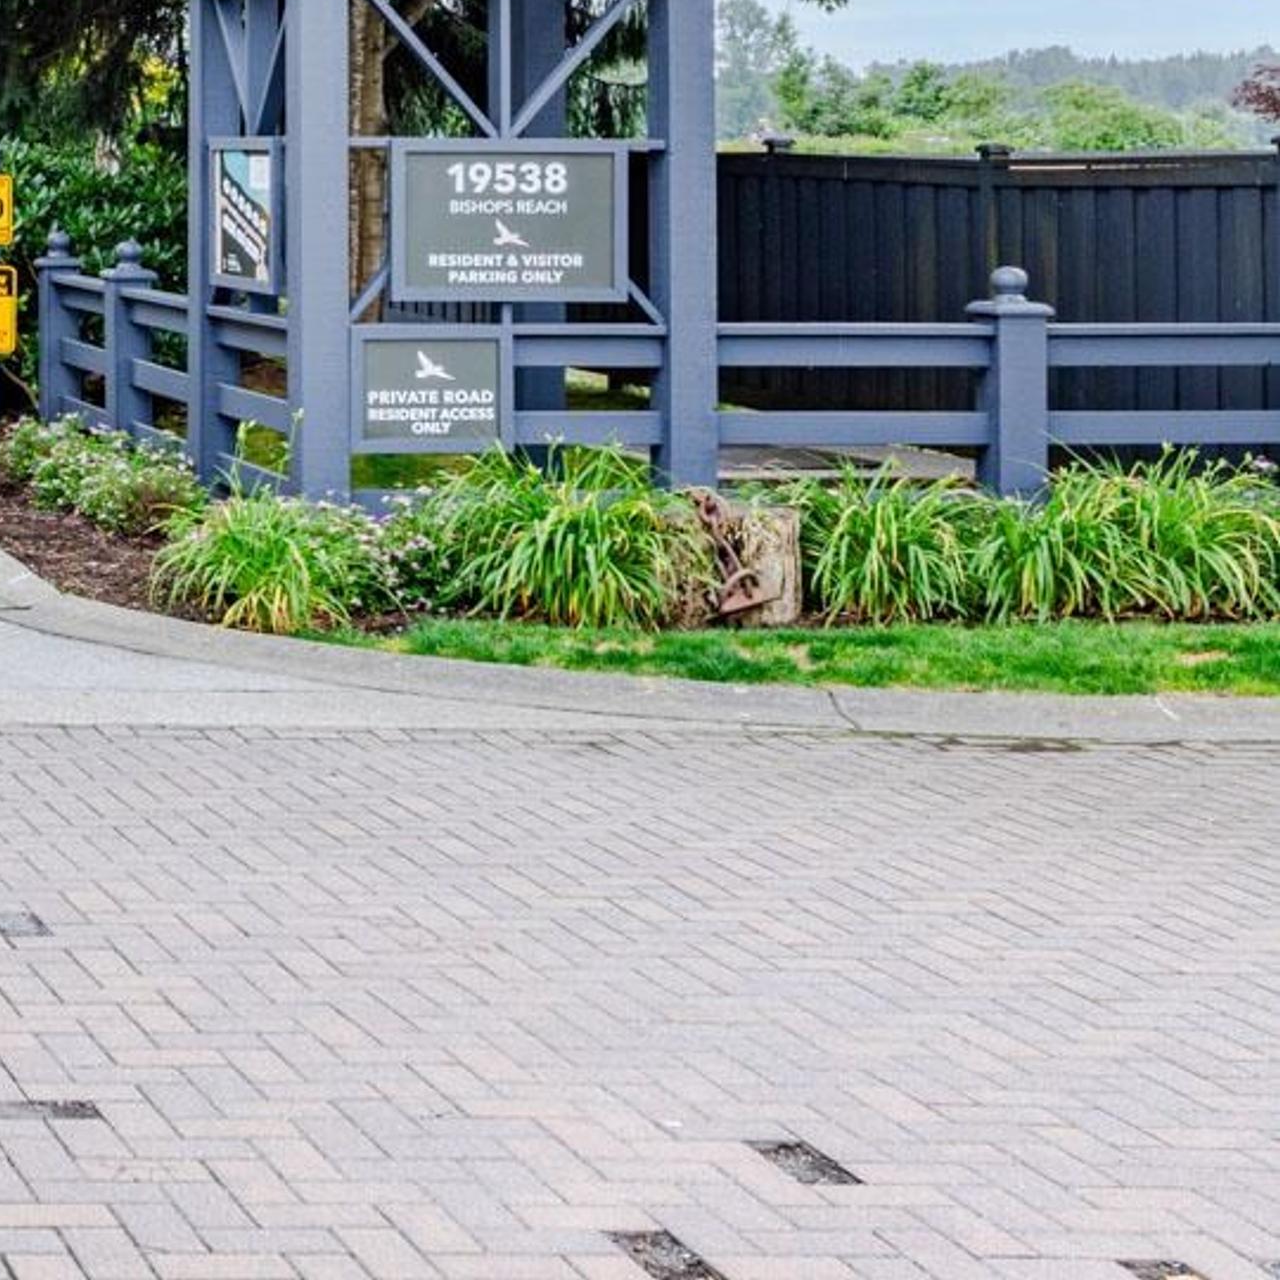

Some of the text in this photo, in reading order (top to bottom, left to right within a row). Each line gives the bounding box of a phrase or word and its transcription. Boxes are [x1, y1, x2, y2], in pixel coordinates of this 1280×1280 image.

[446, 161, 568, 194] 19538
[449, 199, 568, 215] BISHOPS REACH
[428, 253, 584, 268] RESIDENT & VISITOR
[447, 269, 564, 284] PARKING ONLY
[367, 389, 495, 405] PRIVATE ROAD
[367, 407, 495, 421] RESIDENT ACCESS
[410, 422, 452, 435] ONLY
